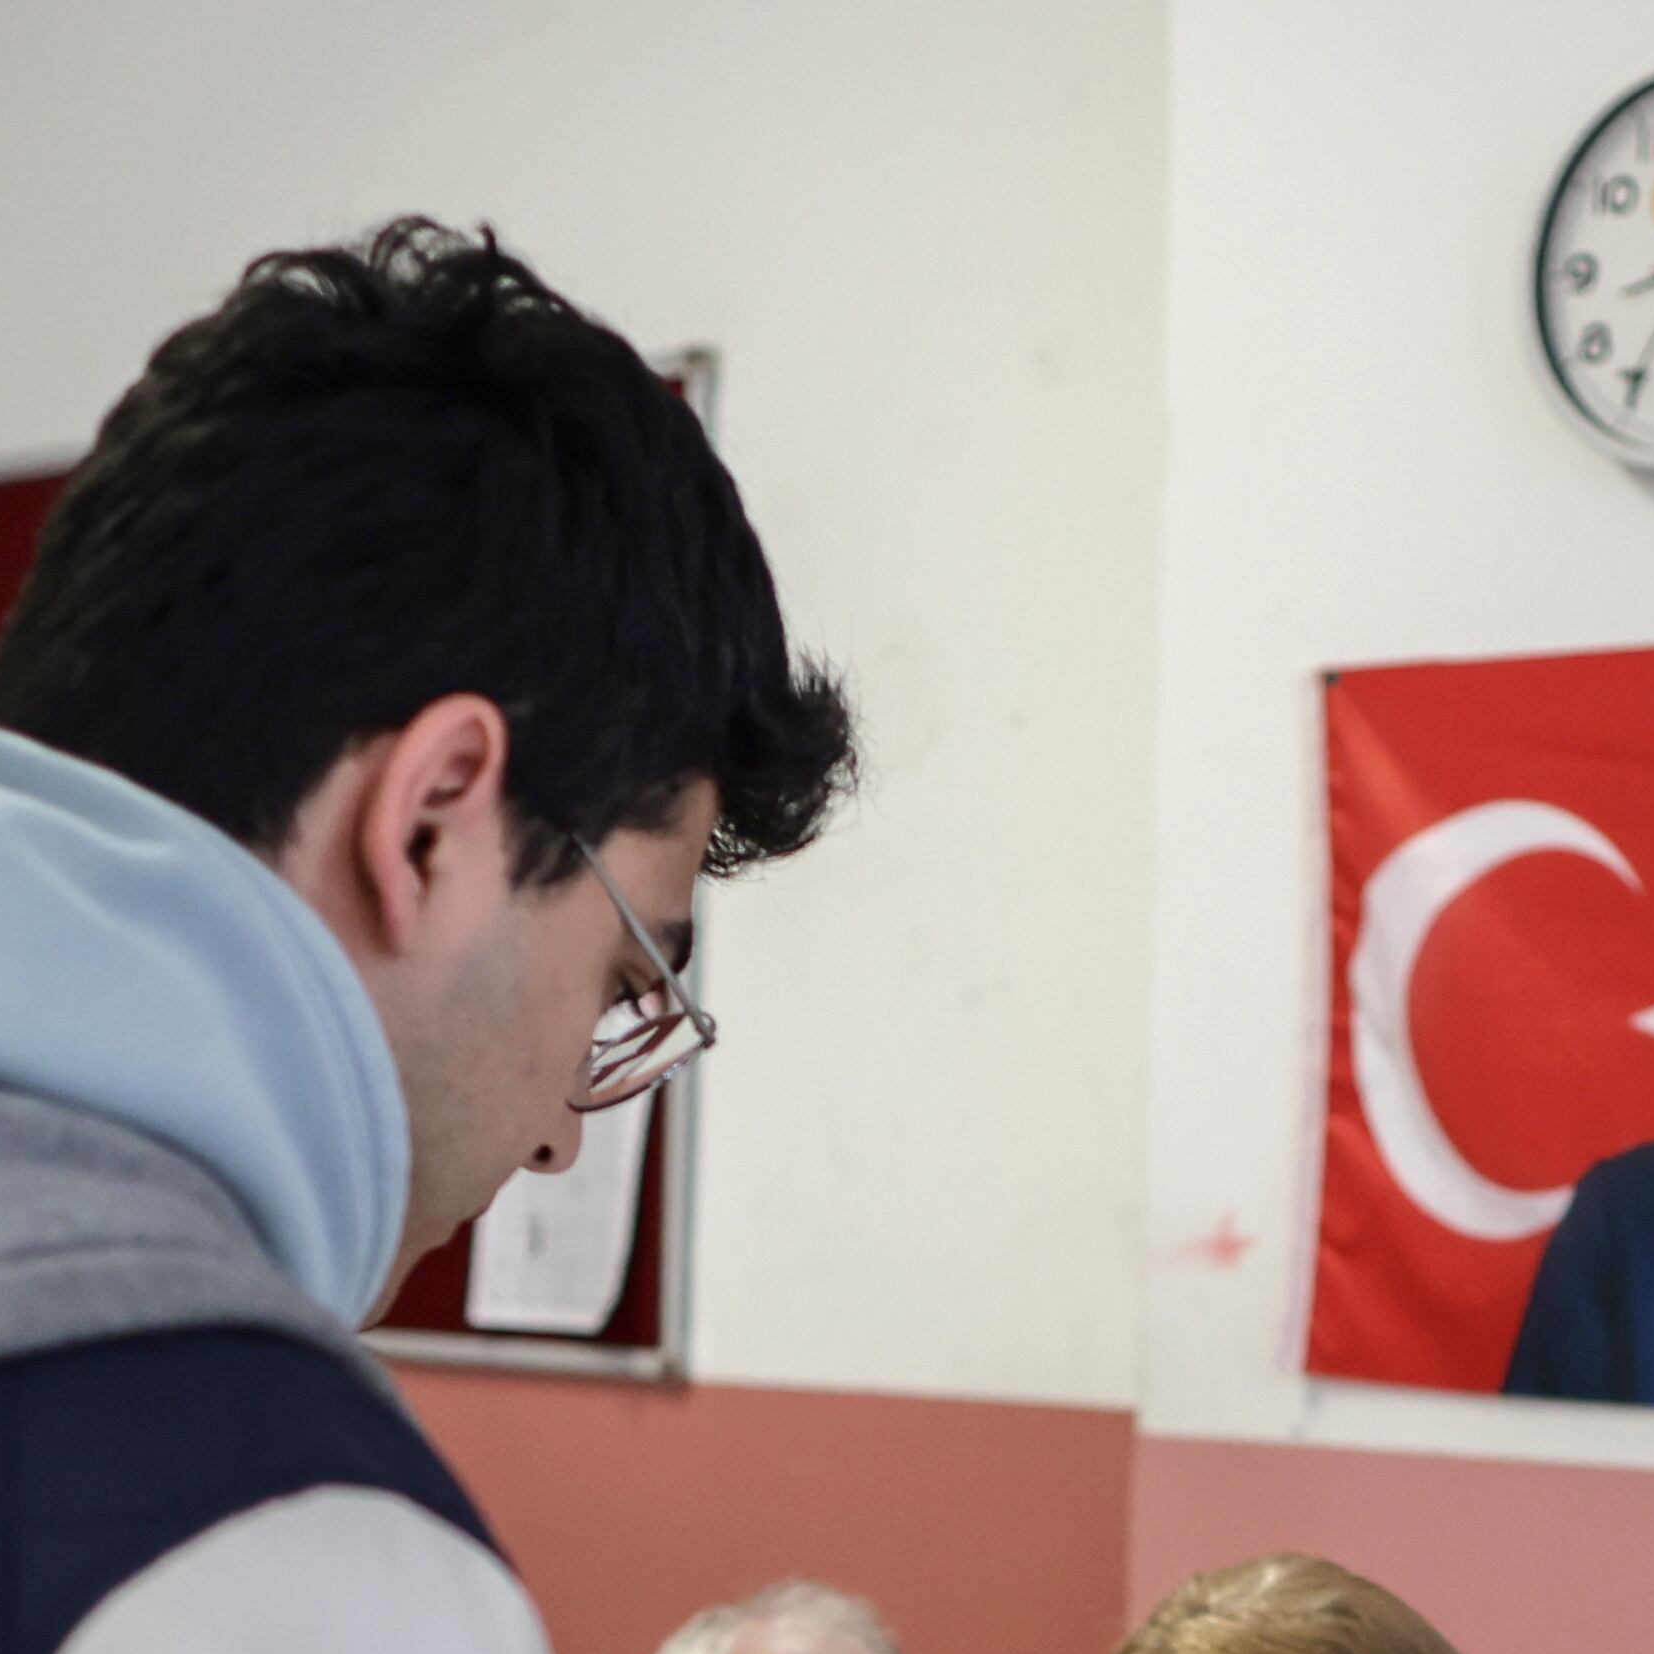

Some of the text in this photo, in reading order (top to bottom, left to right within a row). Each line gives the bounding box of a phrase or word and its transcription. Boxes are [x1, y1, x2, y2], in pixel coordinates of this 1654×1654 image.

[1593, 174, 1639, 215] 10
[1565, 252, 1598, 294] 9
[1580, 321, 1612, 363] 8
[1621, 367, 1648, 407] 7
